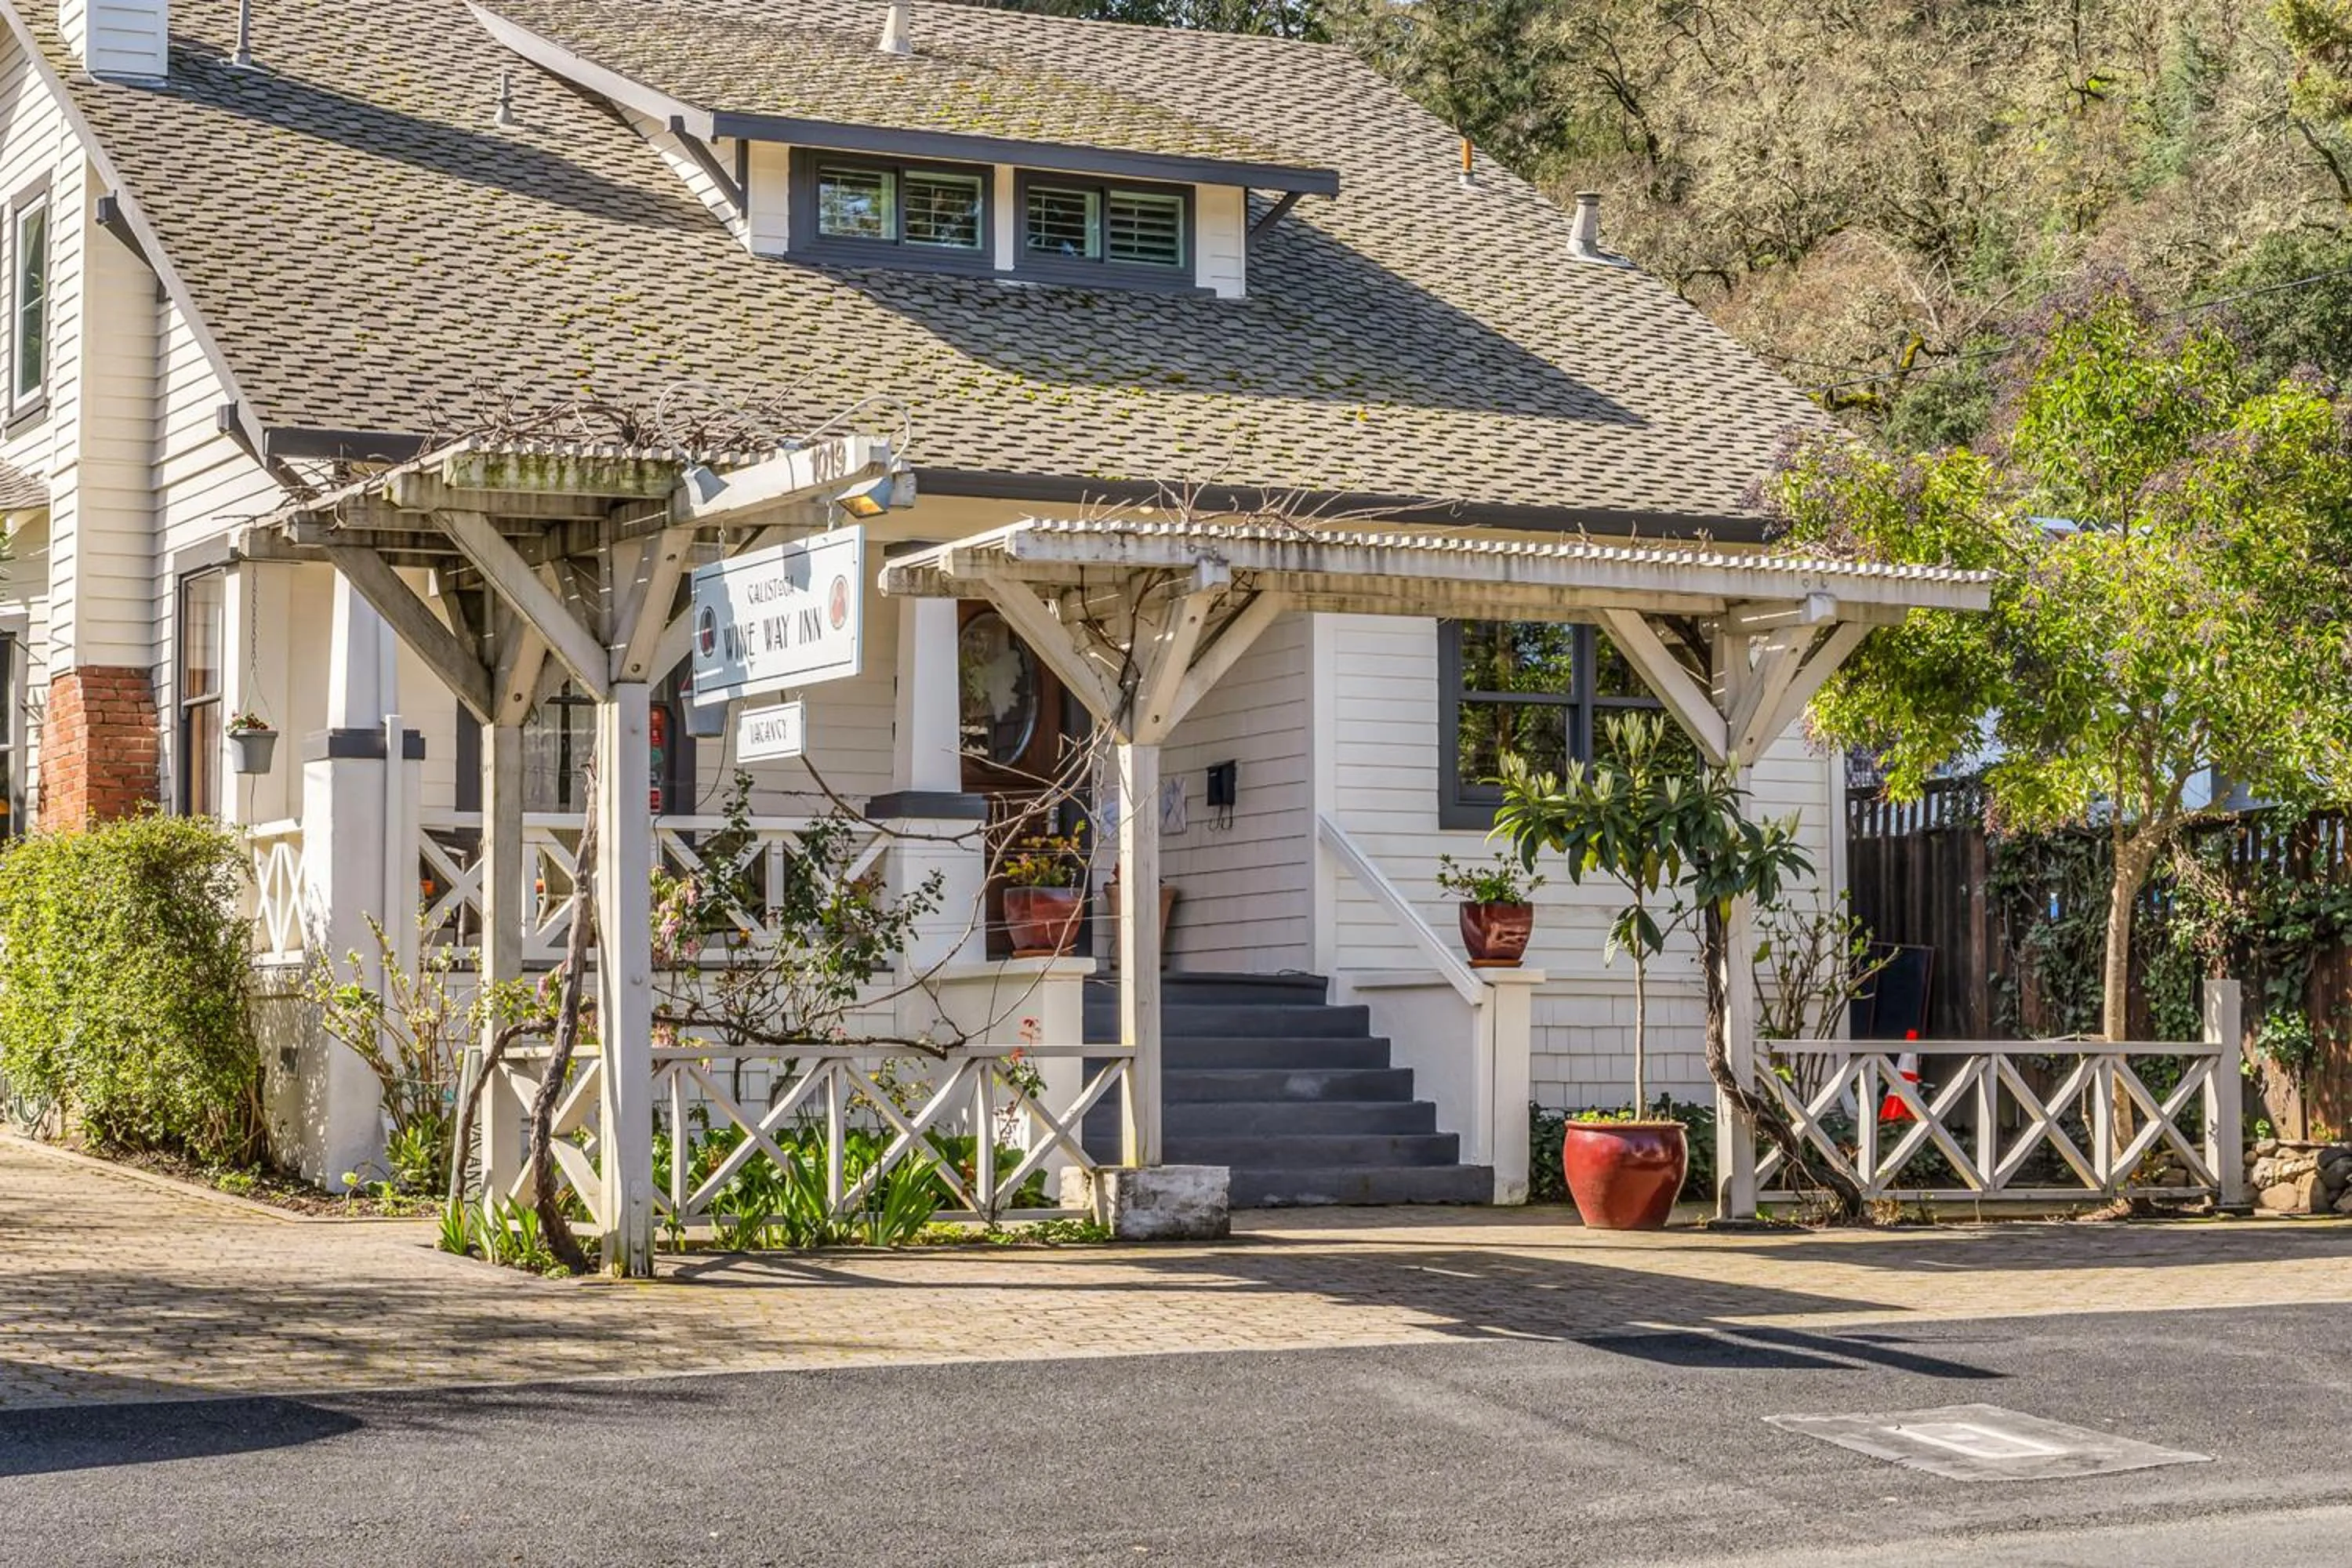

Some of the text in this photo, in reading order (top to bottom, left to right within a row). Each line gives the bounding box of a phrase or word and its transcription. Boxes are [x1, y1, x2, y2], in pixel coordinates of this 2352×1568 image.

[809, 440, 847, 483] 1019
[748, 575, 793, 604] CALISTOGA
[724, 607, 822, 661] WINE WAY INN
[750, 719, 786, 745] VACANCY
